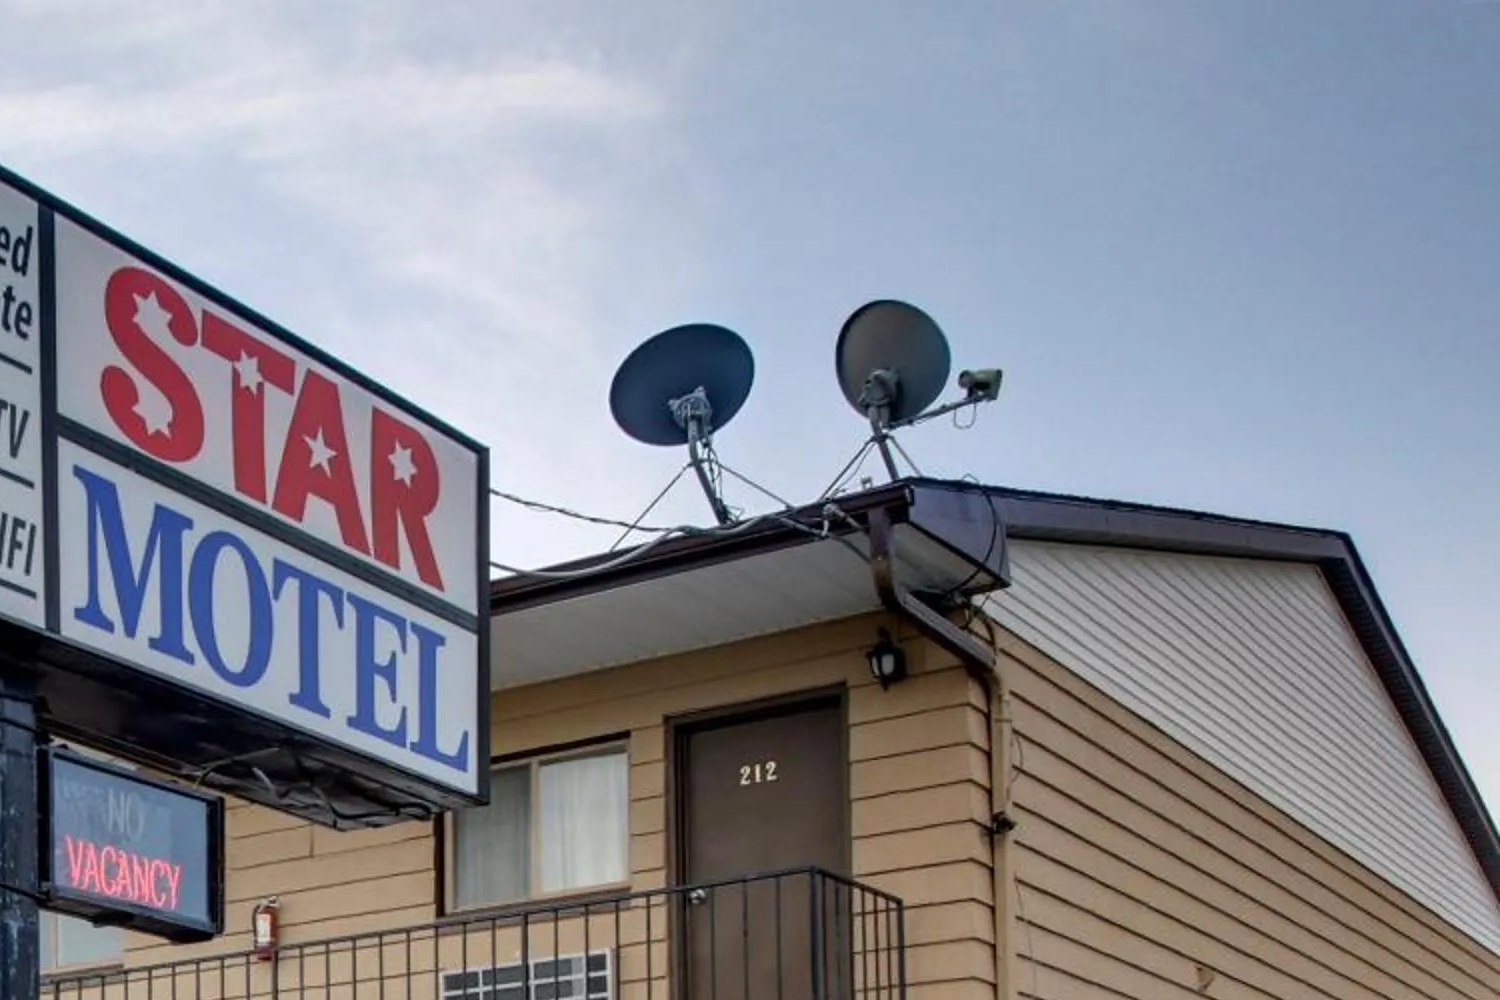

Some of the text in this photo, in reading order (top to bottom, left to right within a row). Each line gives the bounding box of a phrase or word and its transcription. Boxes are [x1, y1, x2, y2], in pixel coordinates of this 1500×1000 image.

[100, 265, 444, 591] STAR
[73, 464, 469, 773] MOTEL
[740, 761, 777, 785] 212
[107, 788, 144, 838] NO
[65, 834, 182, 910] VACANCY
